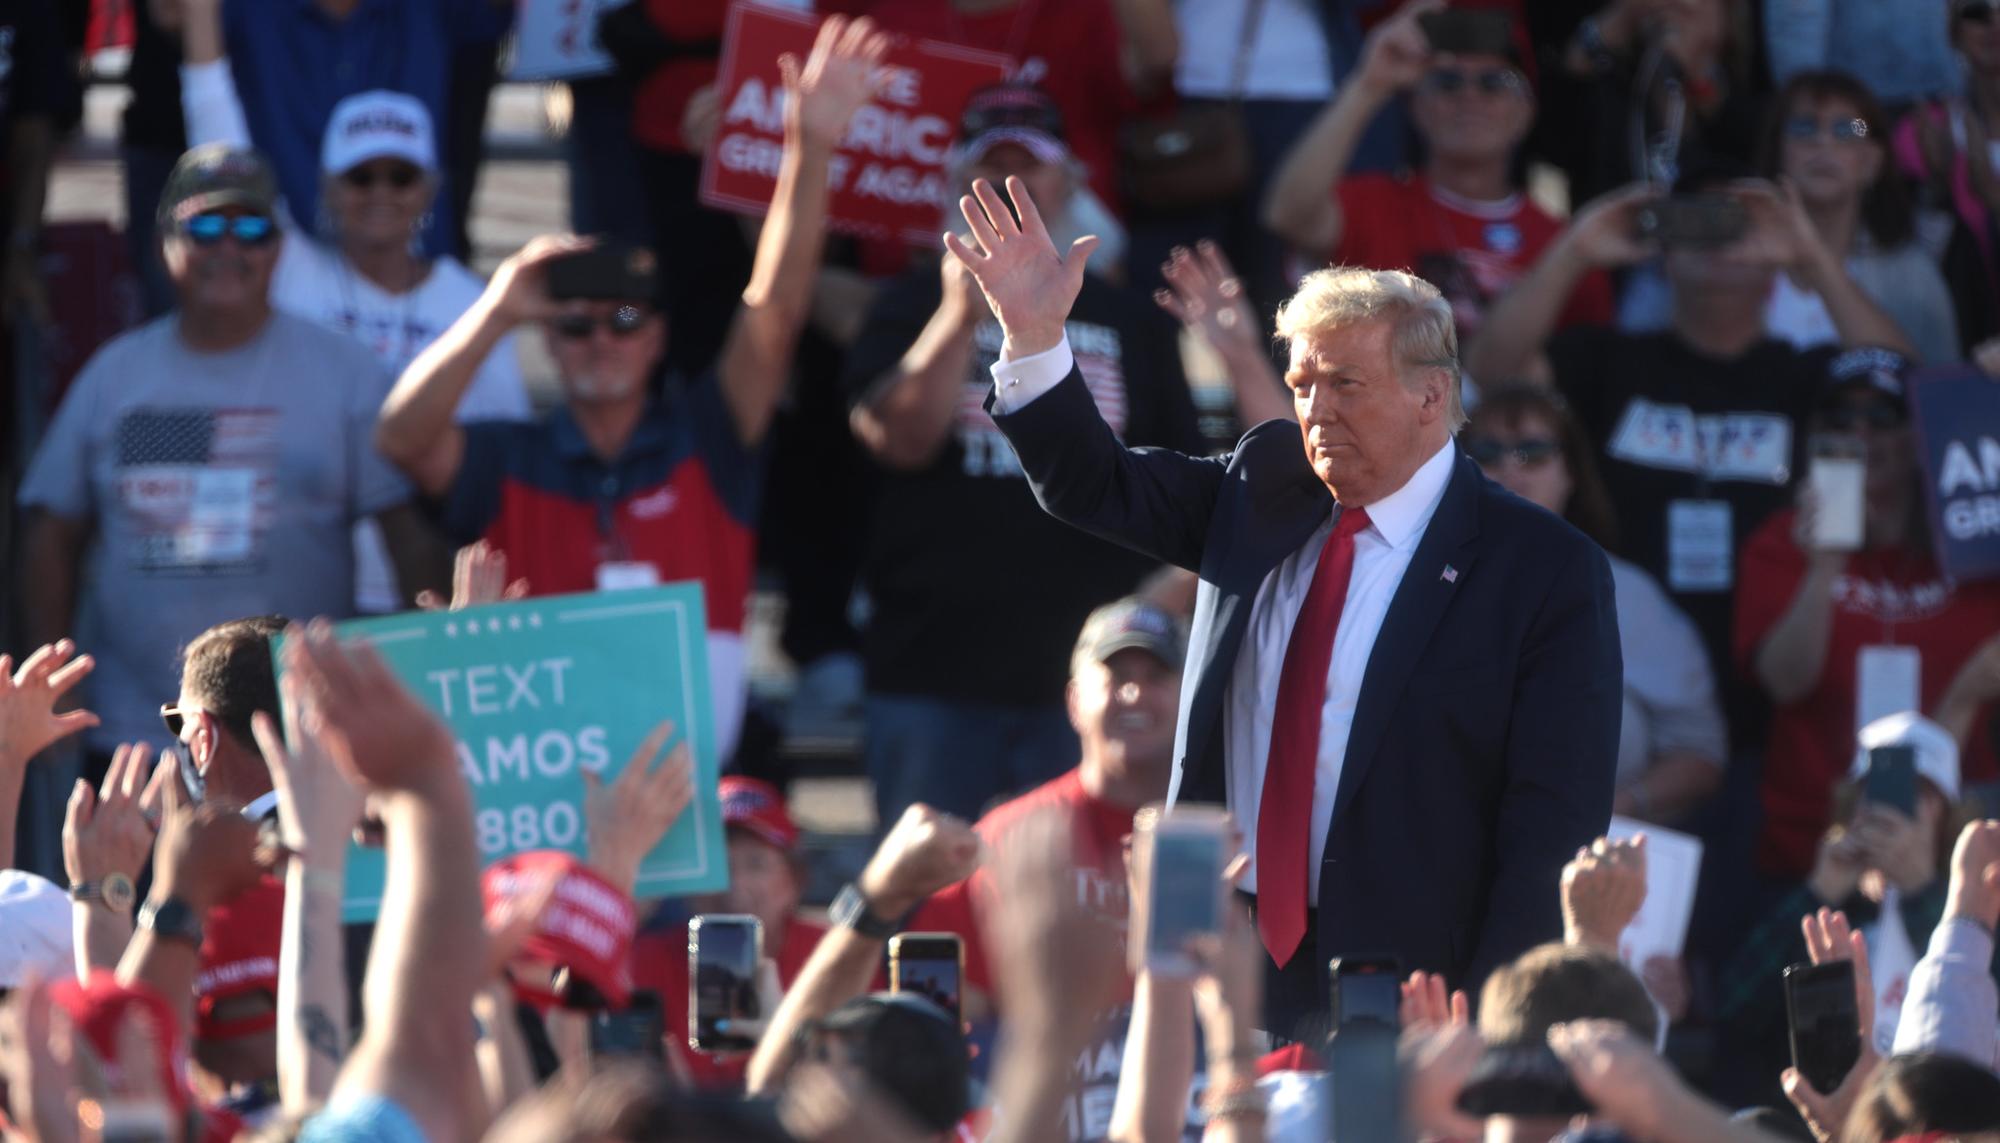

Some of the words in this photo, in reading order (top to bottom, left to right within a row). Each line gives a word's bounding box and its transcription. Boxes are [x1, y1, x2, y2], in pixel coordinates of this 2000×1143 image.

[426, 656, 572, 717] TEXT
[453, 726, 611, 786] AMOS
[475, 799, 588, 854] 880
